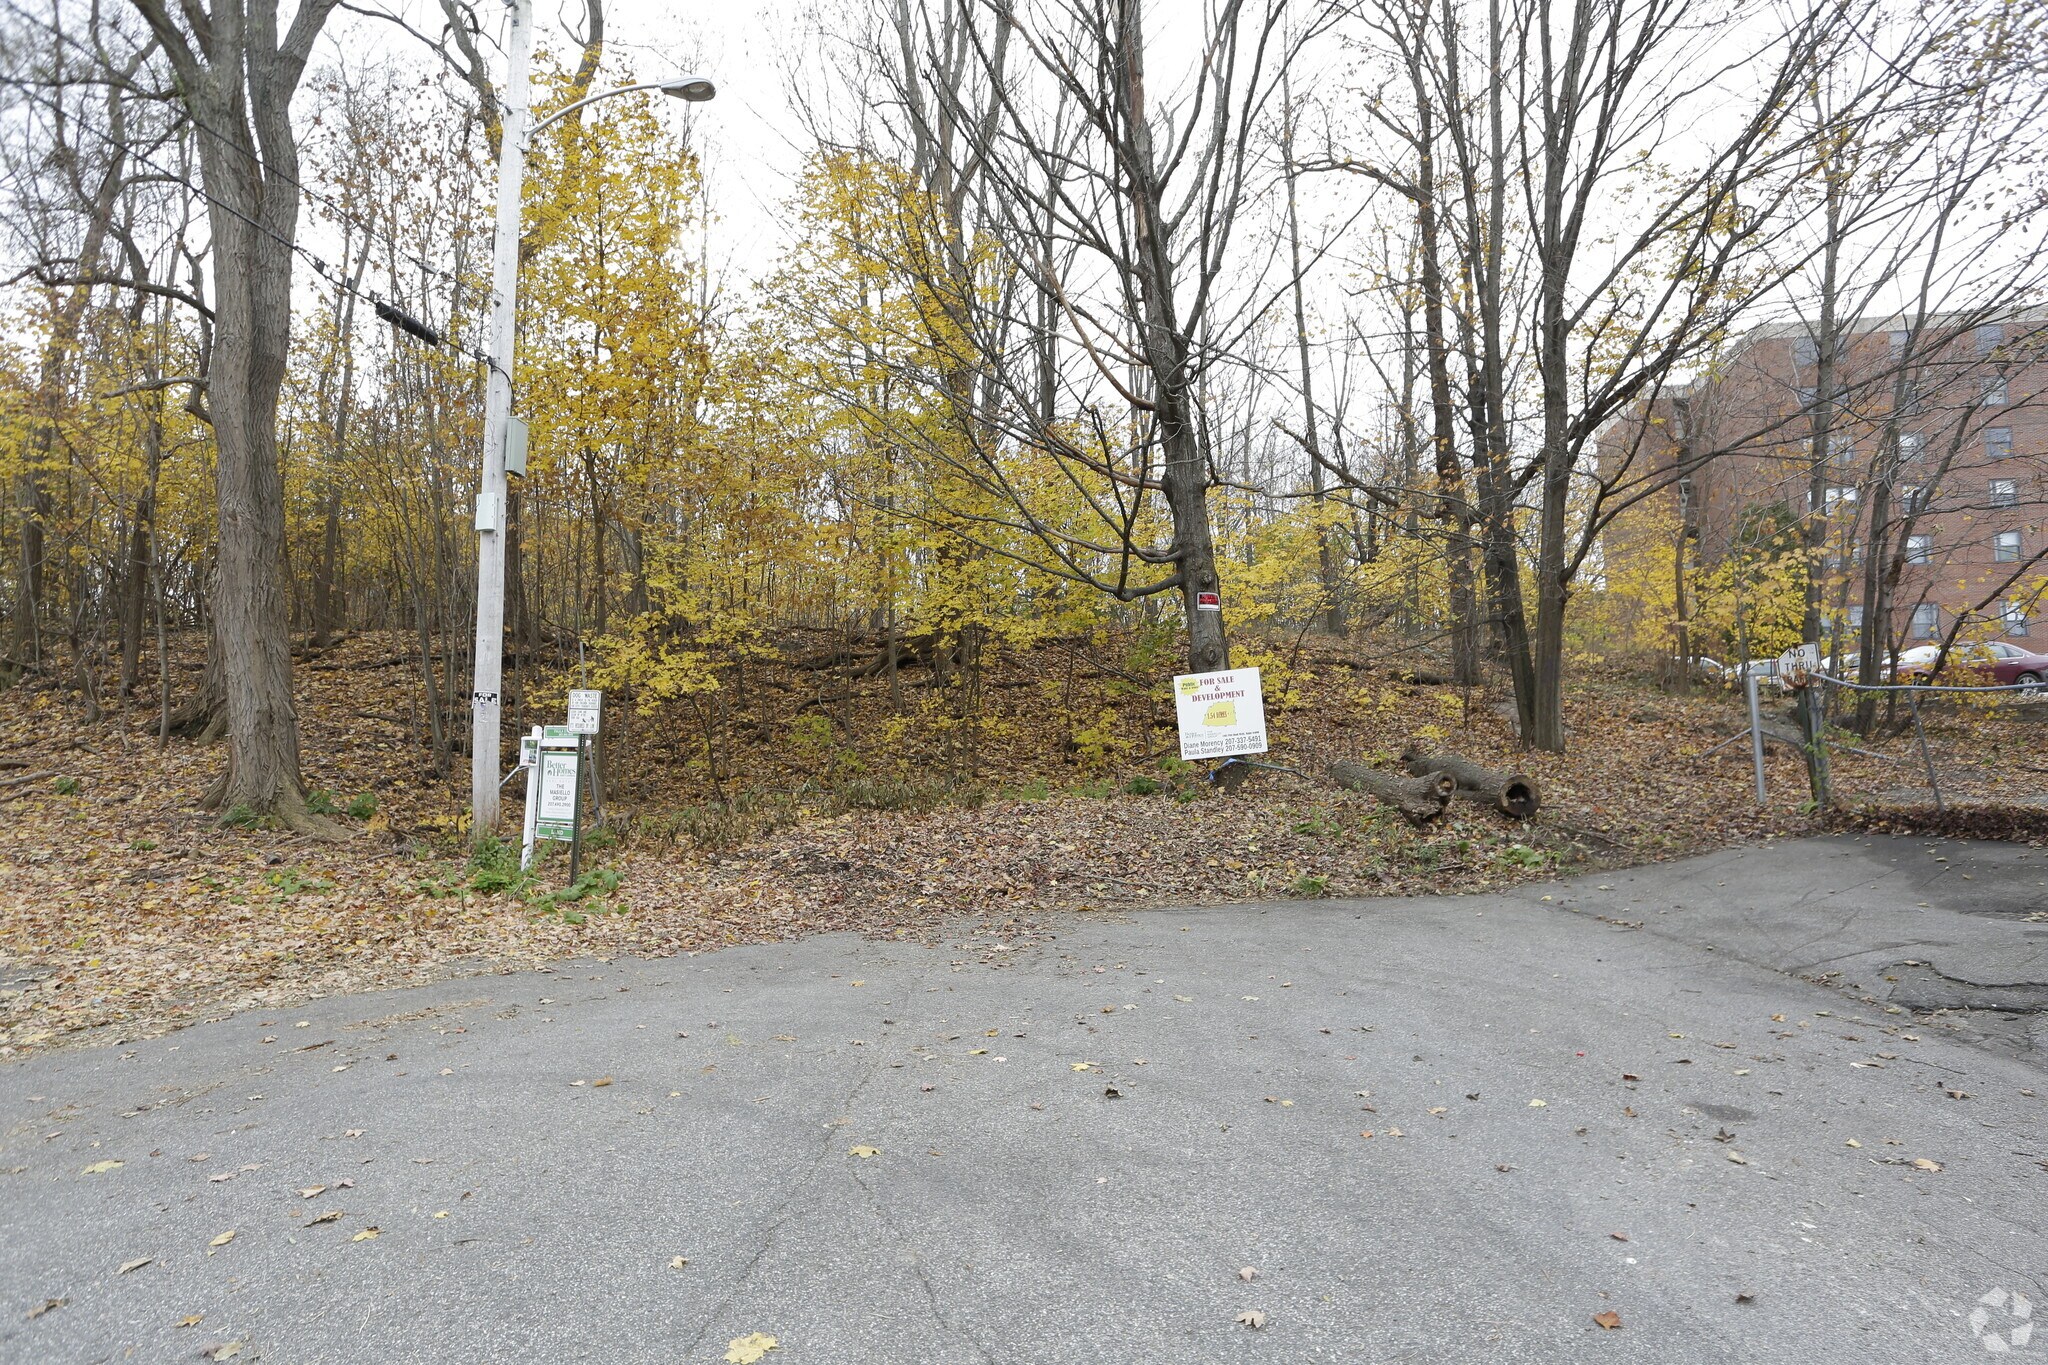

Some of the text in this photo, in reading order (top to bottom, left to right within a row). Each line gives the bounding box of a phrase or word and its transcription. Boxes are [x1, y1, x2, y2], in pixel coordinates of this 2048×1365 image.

[1788, 649, 1805, 658] NO
[1785, 661, 1812, 671] THRU
[1199, 676, 1235, 686] FOR SALE
[1192, 690, 1245, 702] DEVELOPMENT
[1200, 739, 1224, 748] Morency
[547, 760, 567, 769] Better
[552, 768, 576, 777] Homes
